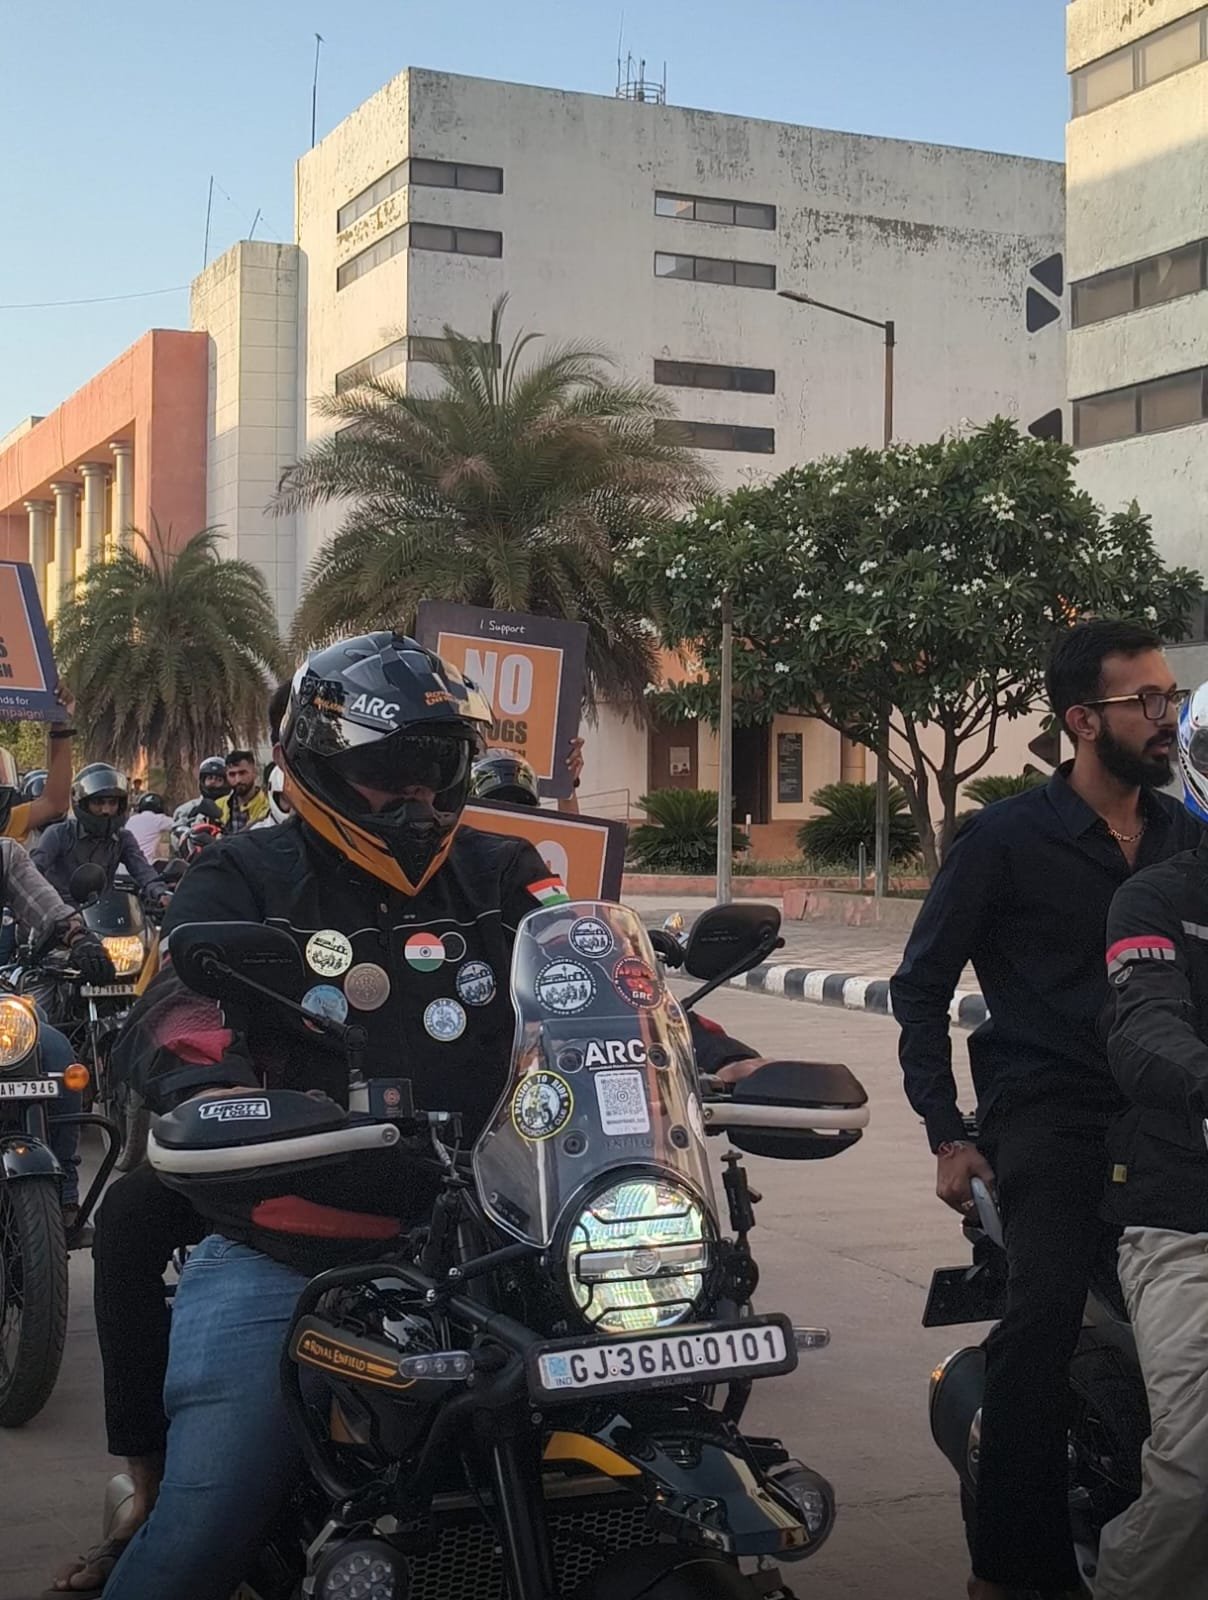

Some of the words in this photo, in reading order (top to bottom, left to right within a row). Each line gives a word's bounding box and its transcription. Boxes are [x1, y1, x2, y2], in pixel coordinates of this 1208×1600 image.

[479, 619, 484, 630] I
[489, 620, 526, 634] Support
[463, 647, 534, 716] NO
[15, 695, 30, 706] for
[350, 693, 400, 719] ARC
[485, 718, 528, 744] UGS
[584, 1038, 647, 1067] ARC
[0, 1083, 16, 1096] AH
[21, 1081, 55, 1095] 7946
[536, 1074, 548, 1084] TO
[551, 1078, 569, 1099] RIDE
[310, 1340, 333, 1360] ROYAL
[333, 1349, 367, 1371] ENFIELD
